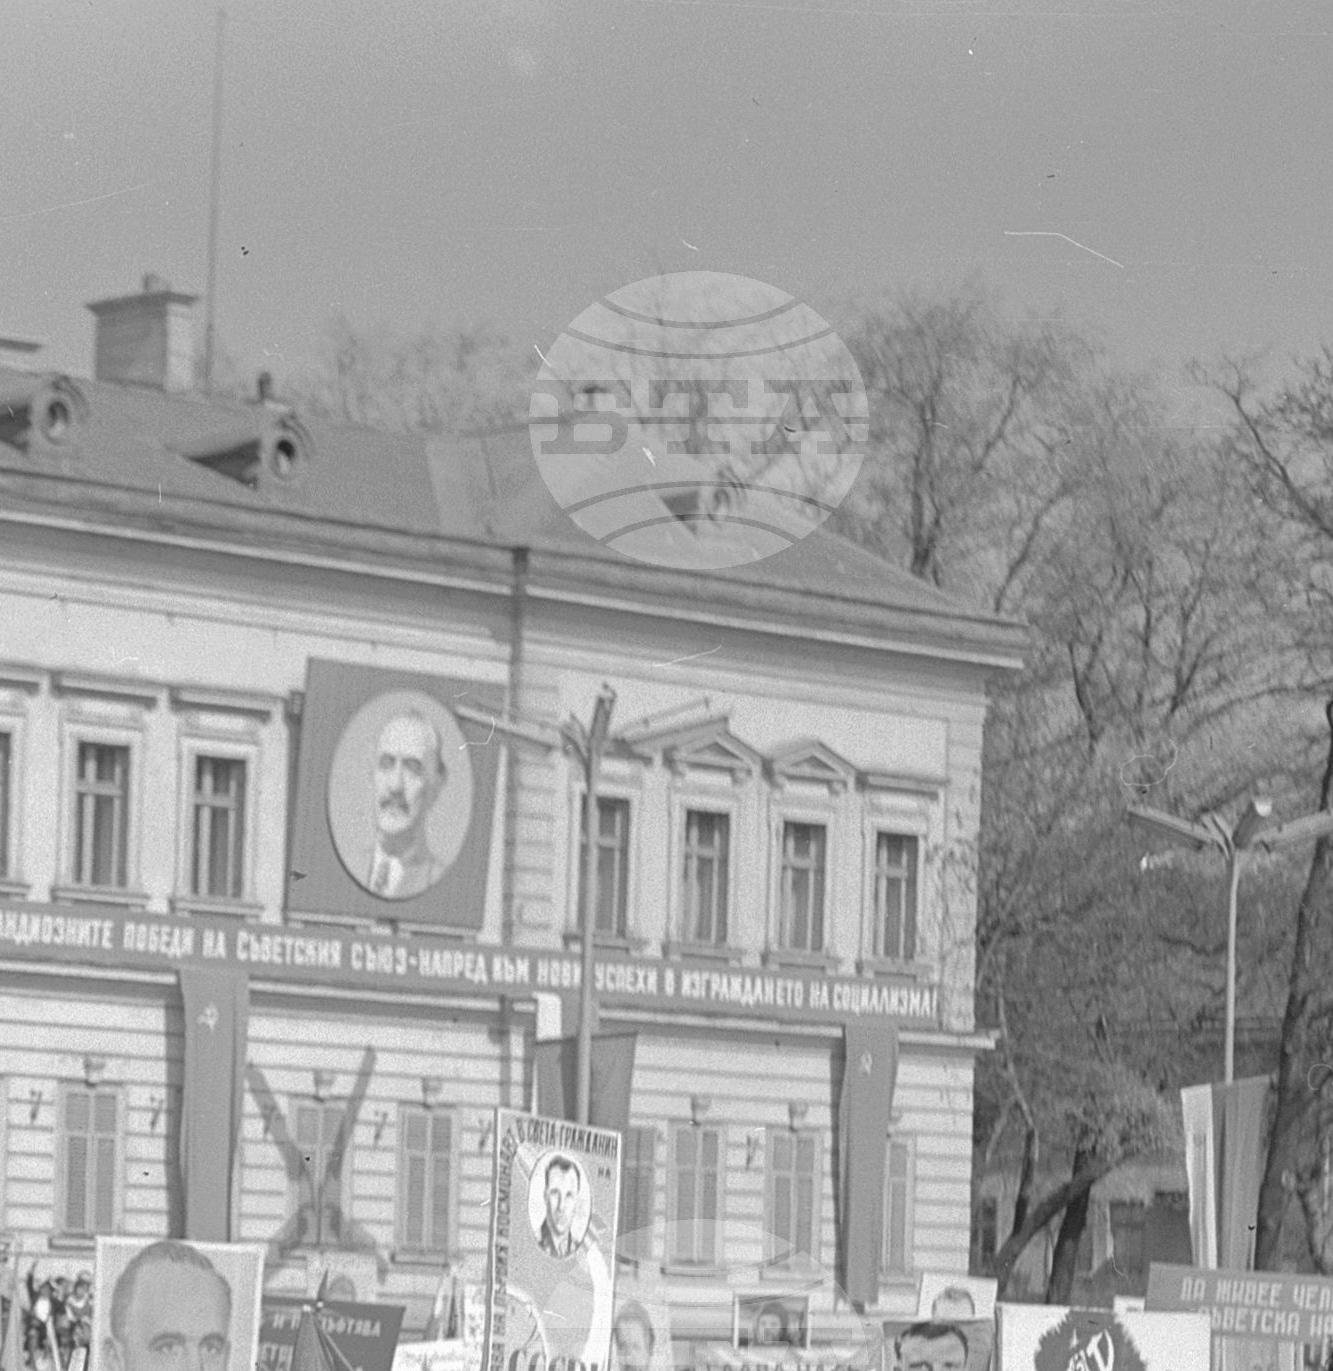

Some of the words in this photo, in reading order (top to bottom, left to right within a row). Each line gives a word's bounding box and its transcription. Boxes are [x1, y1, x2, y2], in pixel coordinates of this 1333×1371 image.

[123, 921, 194, 958] ПОБЕДИ
[202, 929, 226, 959] НА
[236, 930, 343, 968] СЪВЕТСКИЯ
[492, 954, 531, 985] КЪМ
[594, 962, 657, 996] УСПЕХИ
[810, 981, 830, 1011] НА
[1216, 1278, 1284, 1308] ЖИВЕЕ
[1292, 1284, 1333, 1312] ЧЕЛ
[1201, 1305, 1300, 1335] ЪВЕТСКА
